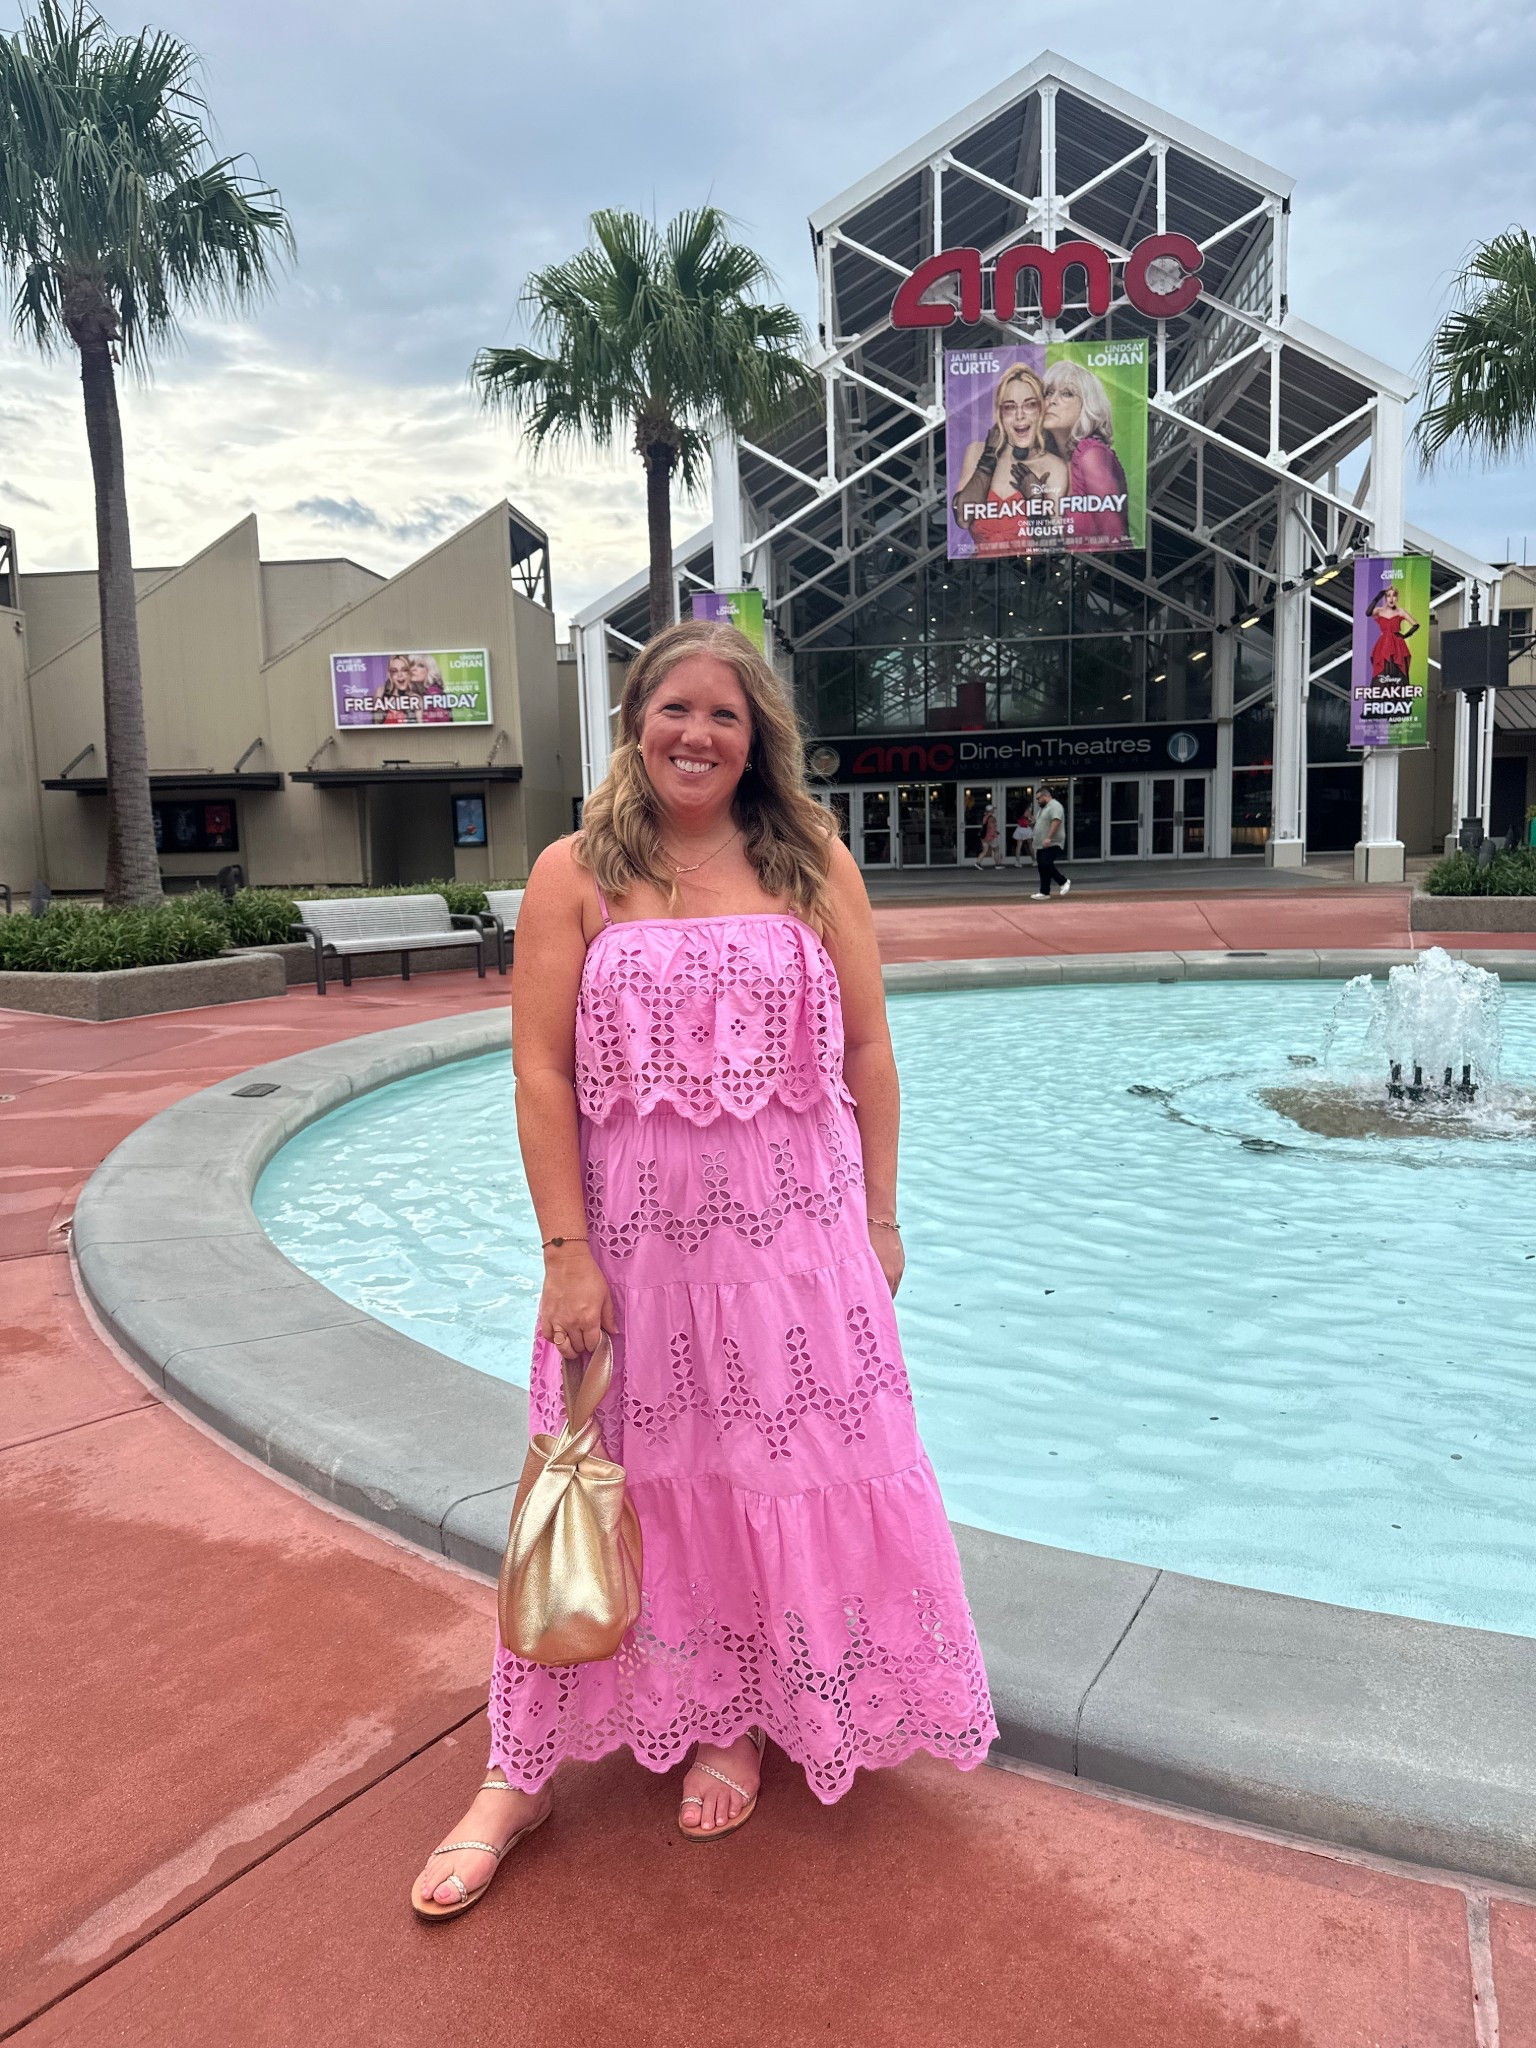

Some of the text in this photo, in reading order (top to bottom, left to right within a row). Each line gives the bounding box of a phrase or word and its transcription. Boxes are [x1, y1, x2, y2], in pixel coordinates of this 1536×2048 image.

[1104, 343, 1144, 354] LINDSAY
[951, 352, 993, 362] JAMIE LEE
[1087, 351, 1144, 367] LOHAN
[950, 360, 1000, 375] CURTIS
[963, 494, 1127, 521] FREAKIER FRIDAY
[1018, 525, 1074, 537] AUGUST 8
[336, 664, 367, 672] CURTIS
[450, 660, 483, 668] LOHAN
[1354, 686, 1423, 700] FREAKIER
[344, 694, 478, 712] FREAKIER FRIDAY
[1363, 701, 1413, 716] FRIDAY
[1035, 758, 1092, 767] MENUS
